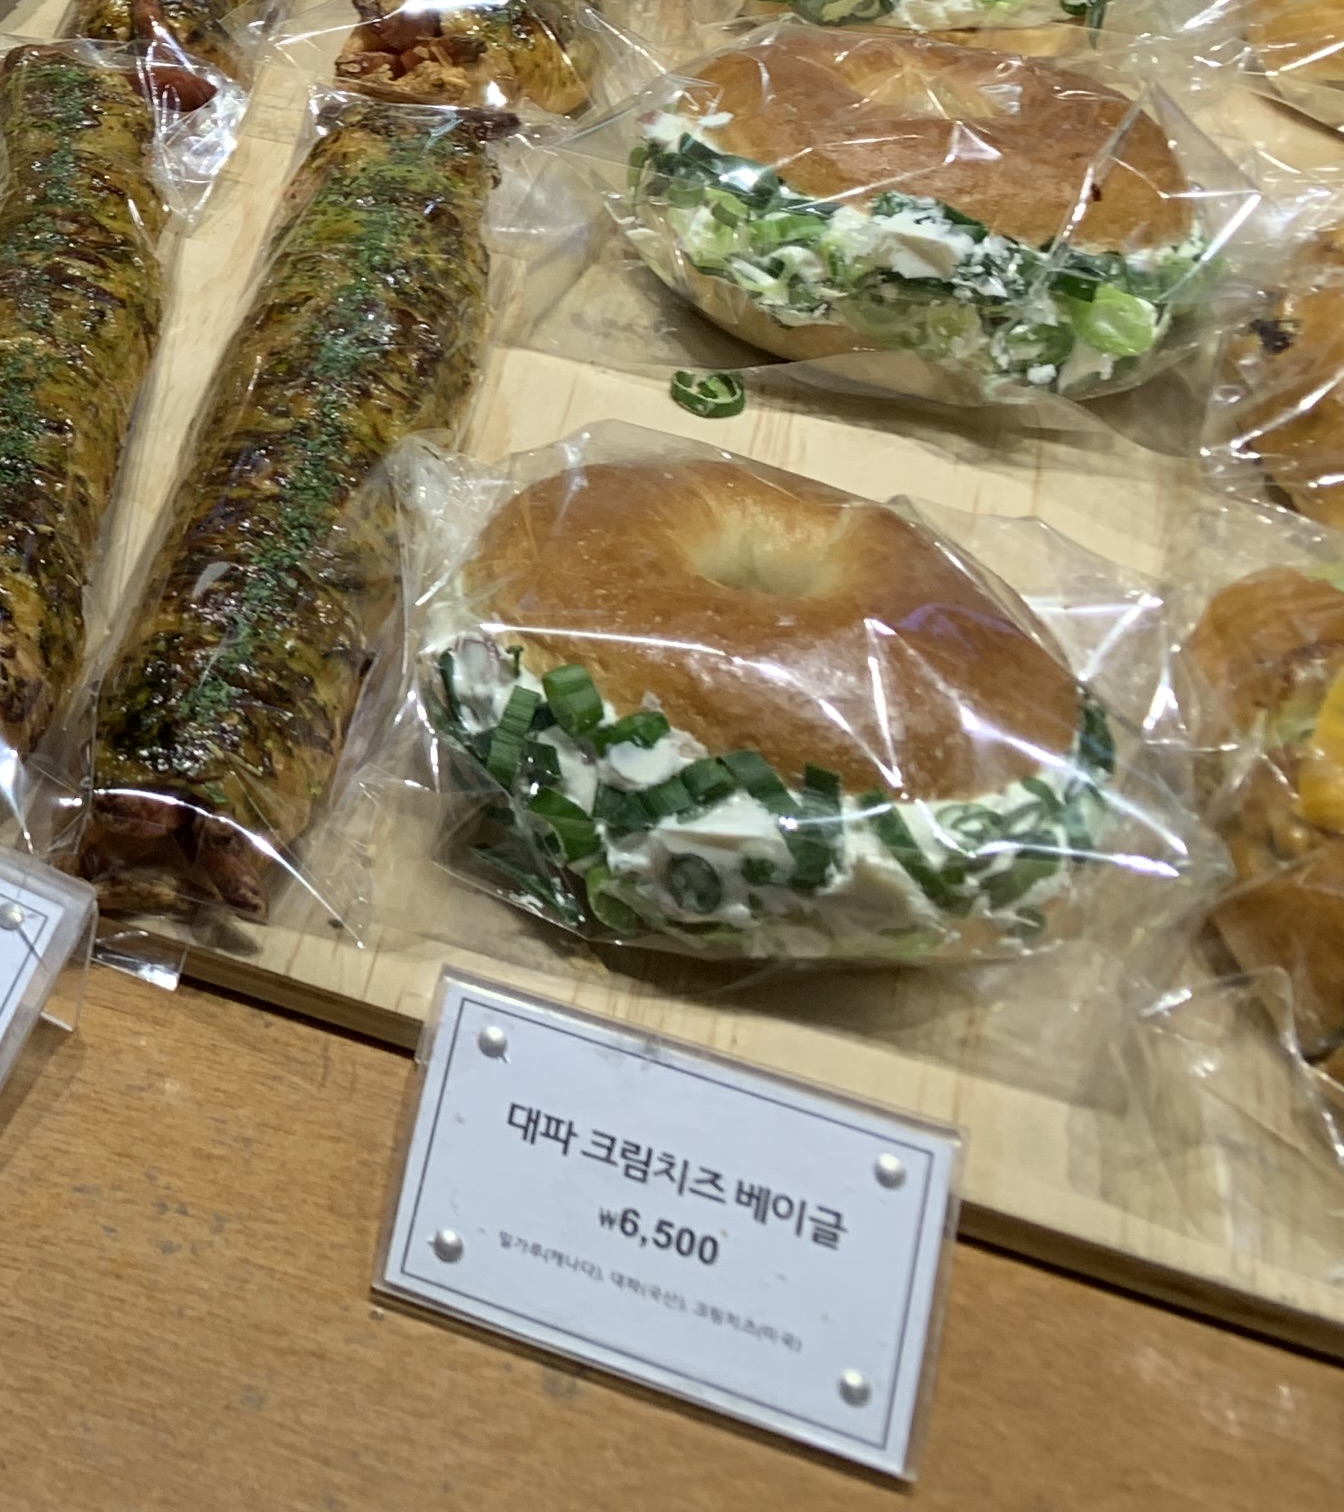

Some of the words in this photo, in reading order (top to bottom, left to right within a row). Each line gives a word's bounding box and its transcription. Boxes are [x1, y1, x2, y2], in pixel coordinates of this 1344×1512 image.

[507, 1101, 579, 1158] 대파
[580, 1125, 727, 1202] 크림치즈
[735, 1176, 850, 1252] 베이글
[597, 1206, 720, 1268] ₩6,500
